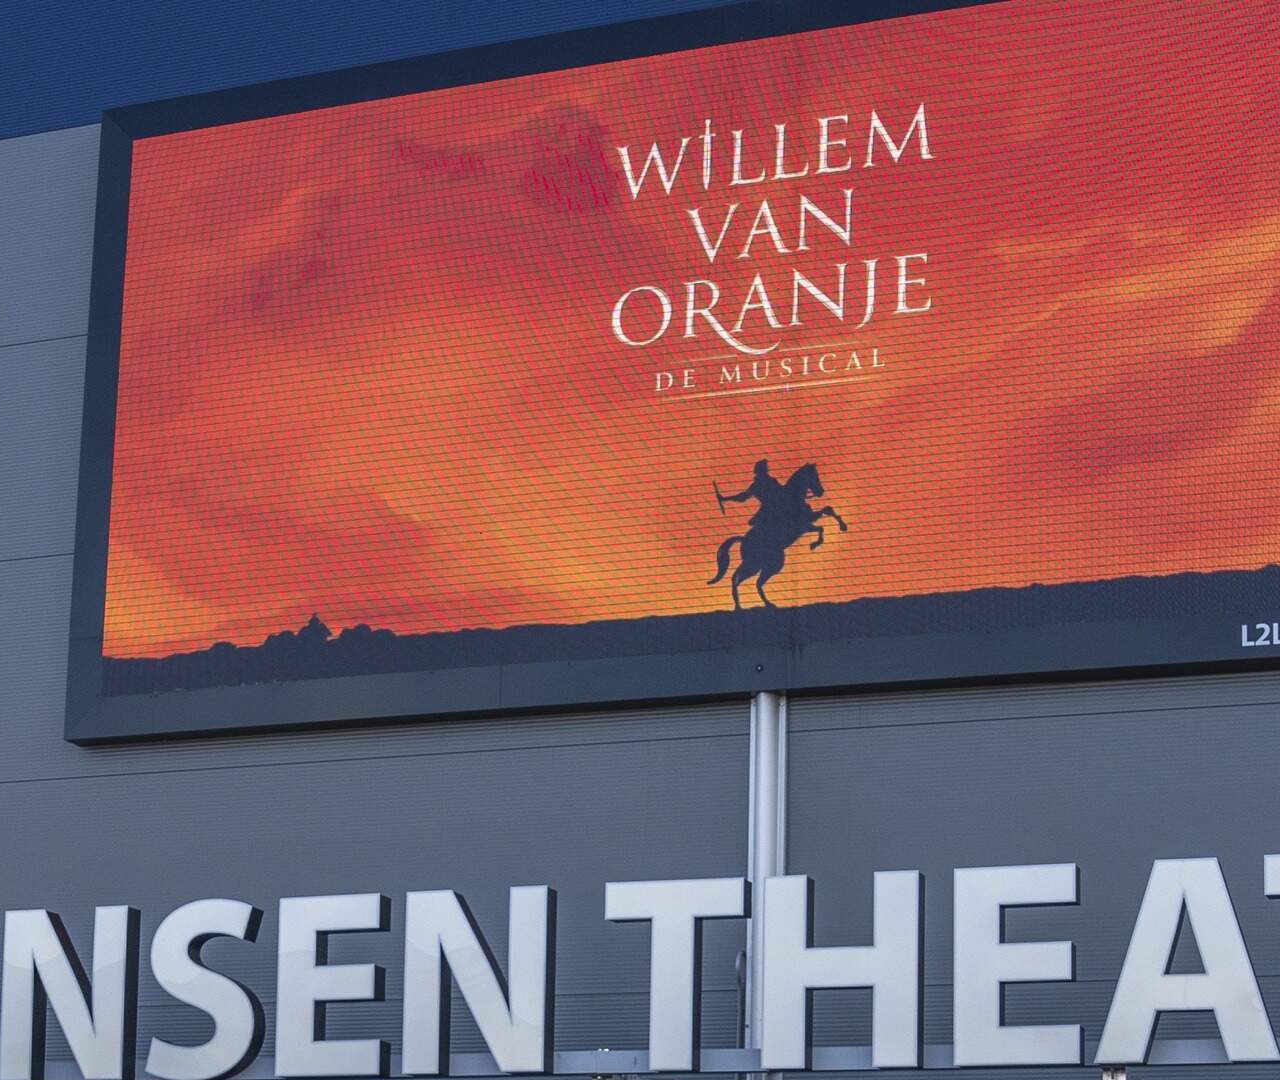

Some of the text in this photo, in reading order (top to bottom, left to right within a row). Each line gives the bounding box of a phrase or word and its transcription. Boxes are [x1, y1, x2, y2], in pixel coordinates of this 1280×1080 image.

[616, 101, 936, 200] WILLEM
[685, 188, 856, 264] VAN
[611, 253, 933, 356] ORANJE
[655, 347, 886, 391] DE MUSICAL
